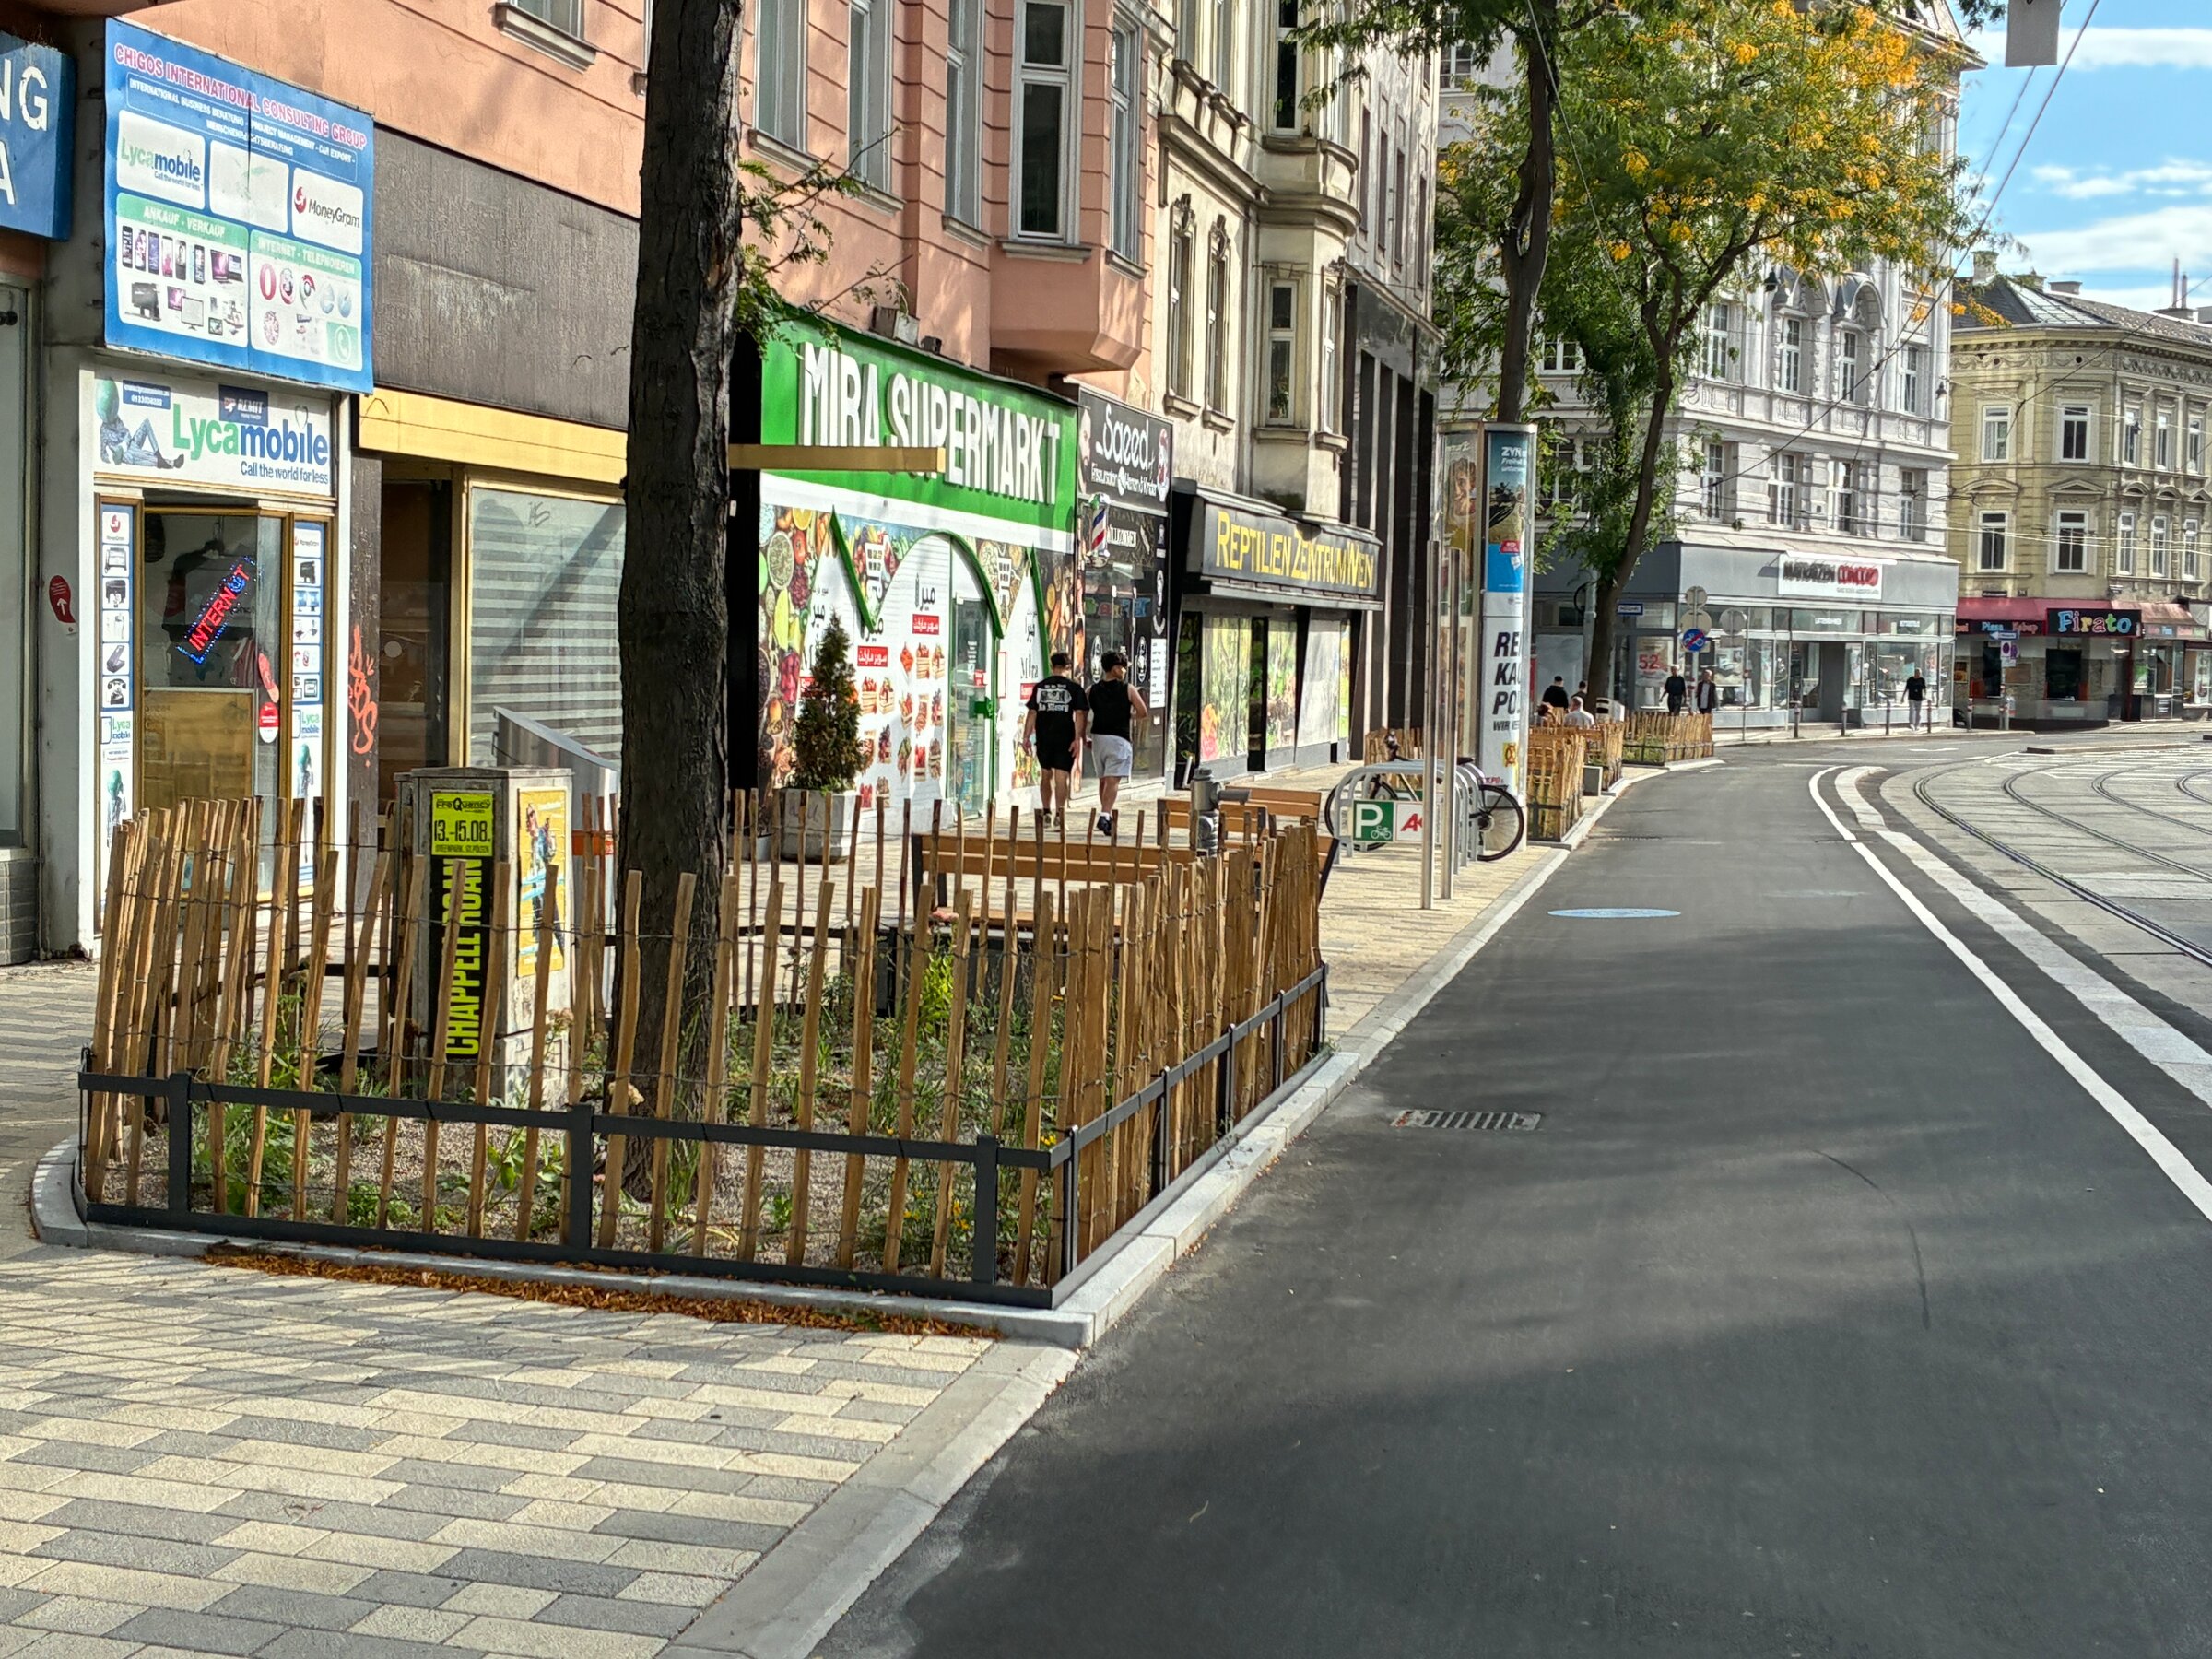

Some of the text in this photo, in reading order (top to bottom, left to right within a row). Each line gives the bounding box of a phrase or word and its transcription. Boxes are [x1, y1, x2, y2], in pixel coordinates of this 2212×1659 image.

[114, 42, 367, 150] CHIGOS INTERNATIONAL CONSULTING GROUP
[143, 205, 226, 238] ANKAUF VERKAUF
[309, 198, 360, 229] MoneyGram
[258, 237, 296, 257] INTERNET
[173, 403, 329, 466] Lycamobile
[798, 341, 1060, 506] MIRA SUPERMARKT
[1097, 403, 1149, 471] Saeed
[241, 461, 329, 485] Call the world for less
[2058, 610, 2132, 634] Firato
[434, 819, 491, 842] 13.-15.08.
[1355, 804, 1383, 839] P
